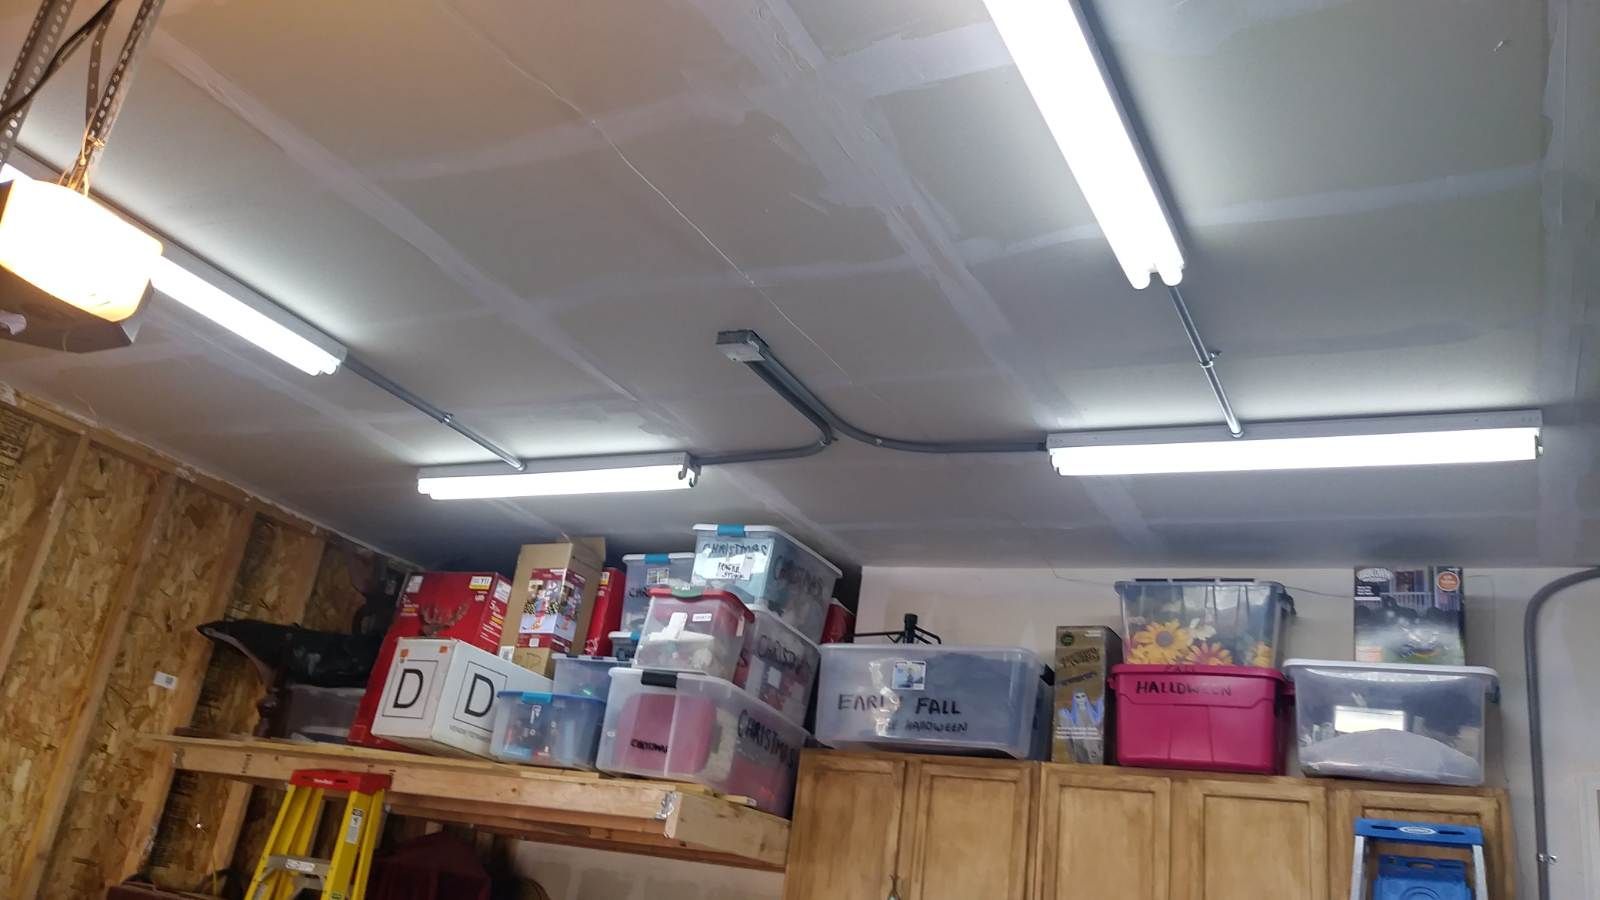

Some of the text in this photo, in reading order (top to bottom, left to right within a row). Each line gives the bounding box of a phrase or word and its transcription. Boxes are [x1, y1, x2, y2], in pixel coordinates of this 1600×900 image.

[393, 668, 423, 708] D
[464, 672, 495, 717] D
[914, 697, 961, 715] FALL
